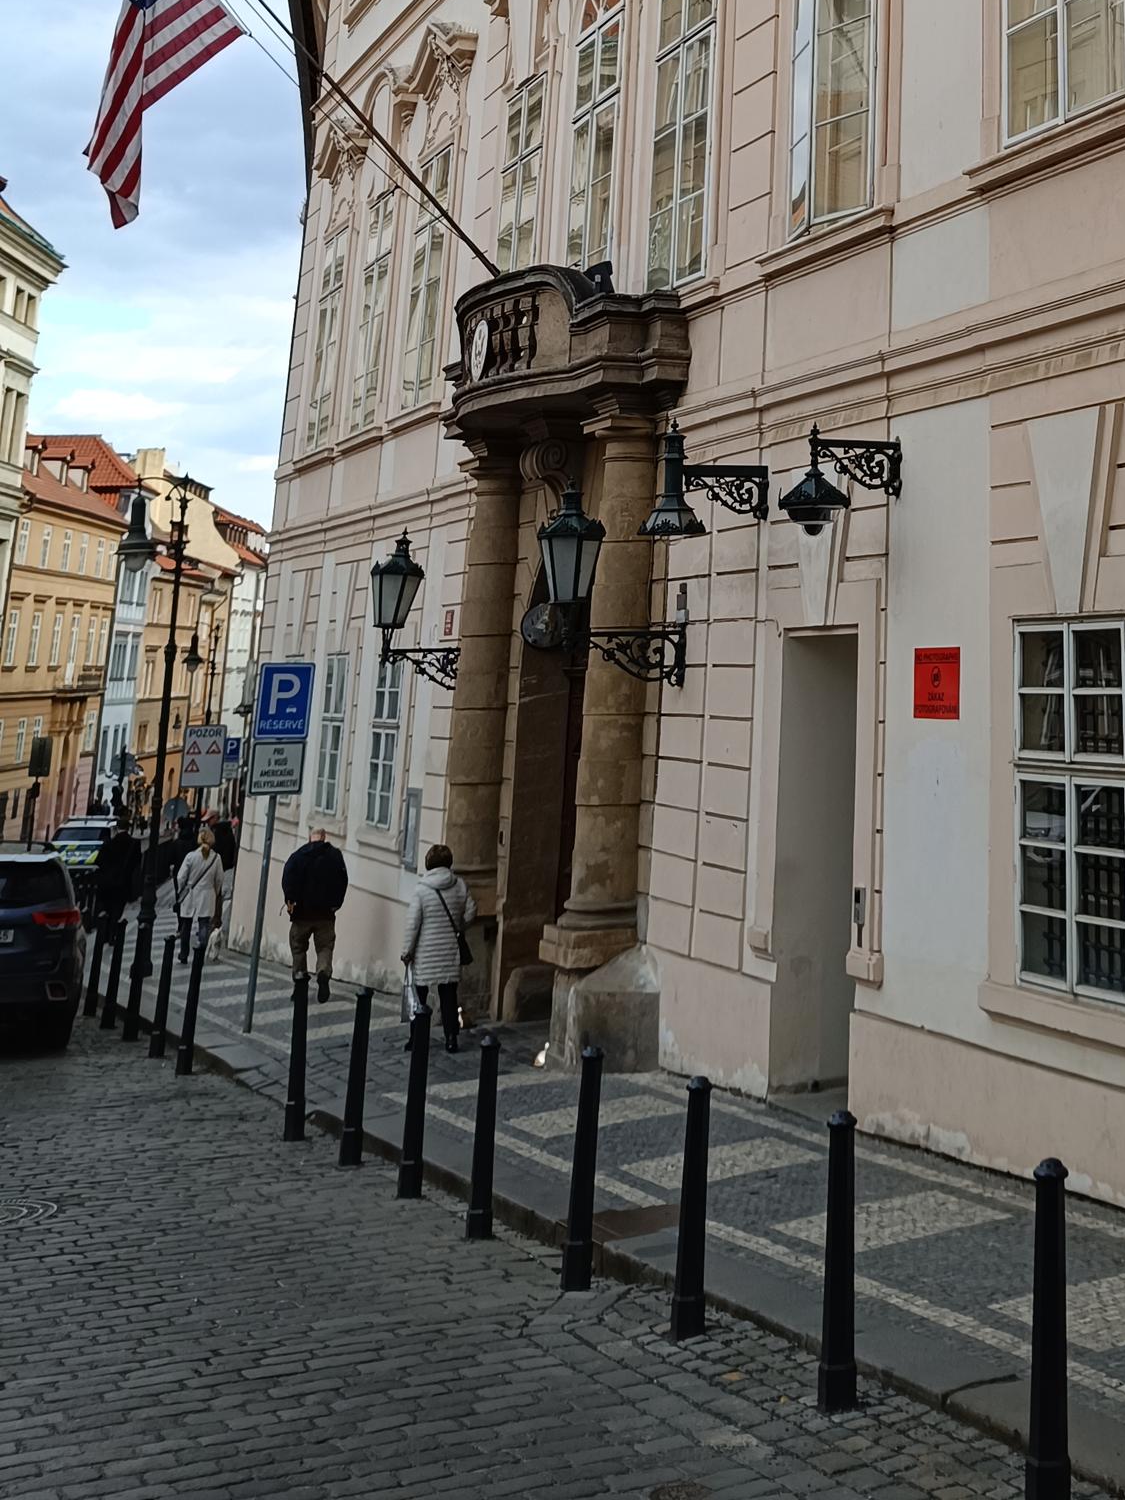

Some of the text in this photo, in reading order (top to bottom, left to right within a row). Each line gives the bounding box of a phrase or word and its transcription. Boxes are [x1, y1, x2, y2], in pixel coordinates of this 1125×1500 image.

[268, 672, 301, 715] P
[189, 728, 222, 738] POZOR
[226, 740, 238, 754] P
